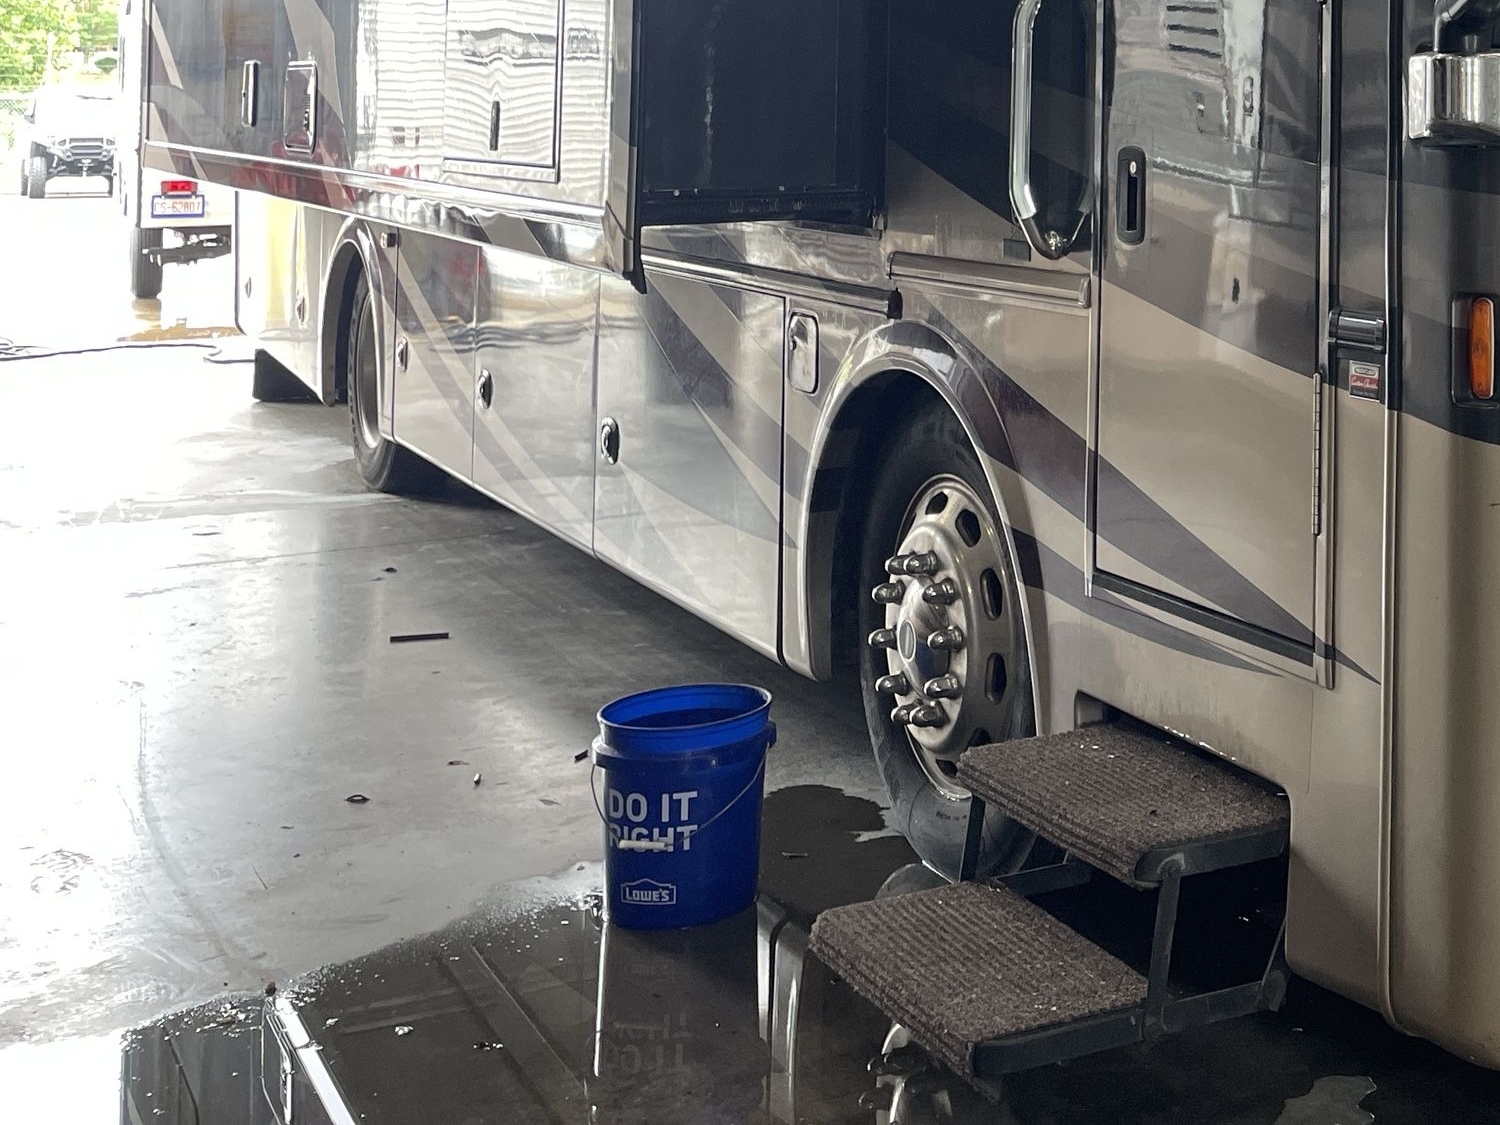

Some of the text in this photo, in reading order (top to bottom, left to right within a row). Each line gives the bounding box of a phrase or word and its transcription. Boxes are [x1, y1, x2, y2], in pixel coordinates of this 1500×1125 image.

[608, 788, 698, 823] DO IT
[608, 824, 698, 853] RIGHT
[625, 886, 670, 902] LOWE'S
